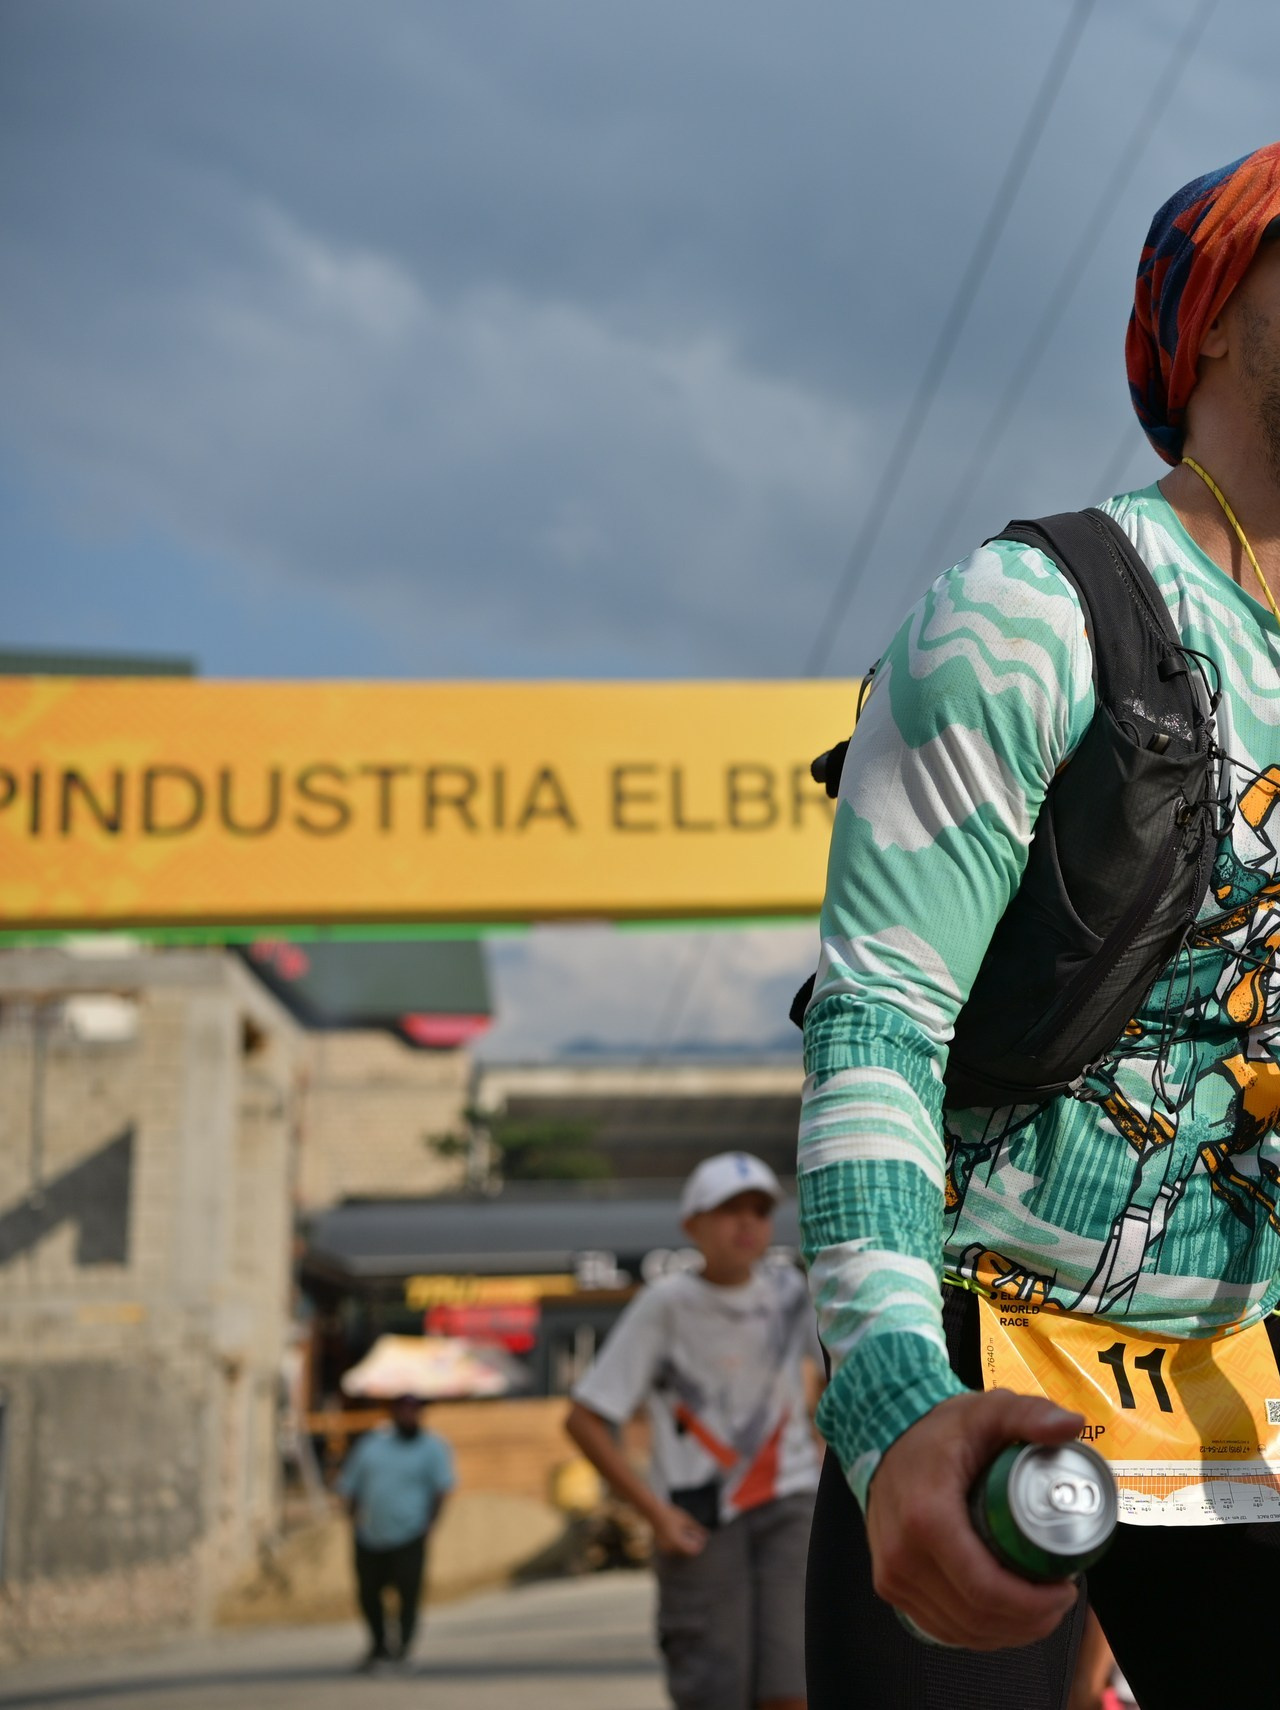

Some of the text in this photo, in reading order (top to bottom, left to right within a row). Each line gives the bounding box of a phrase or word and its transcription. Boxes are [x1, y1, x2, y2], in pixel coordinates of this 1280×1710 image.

[1000, 1304, 1040, 1315] WORLD
[1000, 1317, 1029, 1327] RACE
[986, 1345, 996, 1374] +7640
[1097, 1342, 1174, 1414] 11
[1077, 1425, 1106, 1442] ДР
